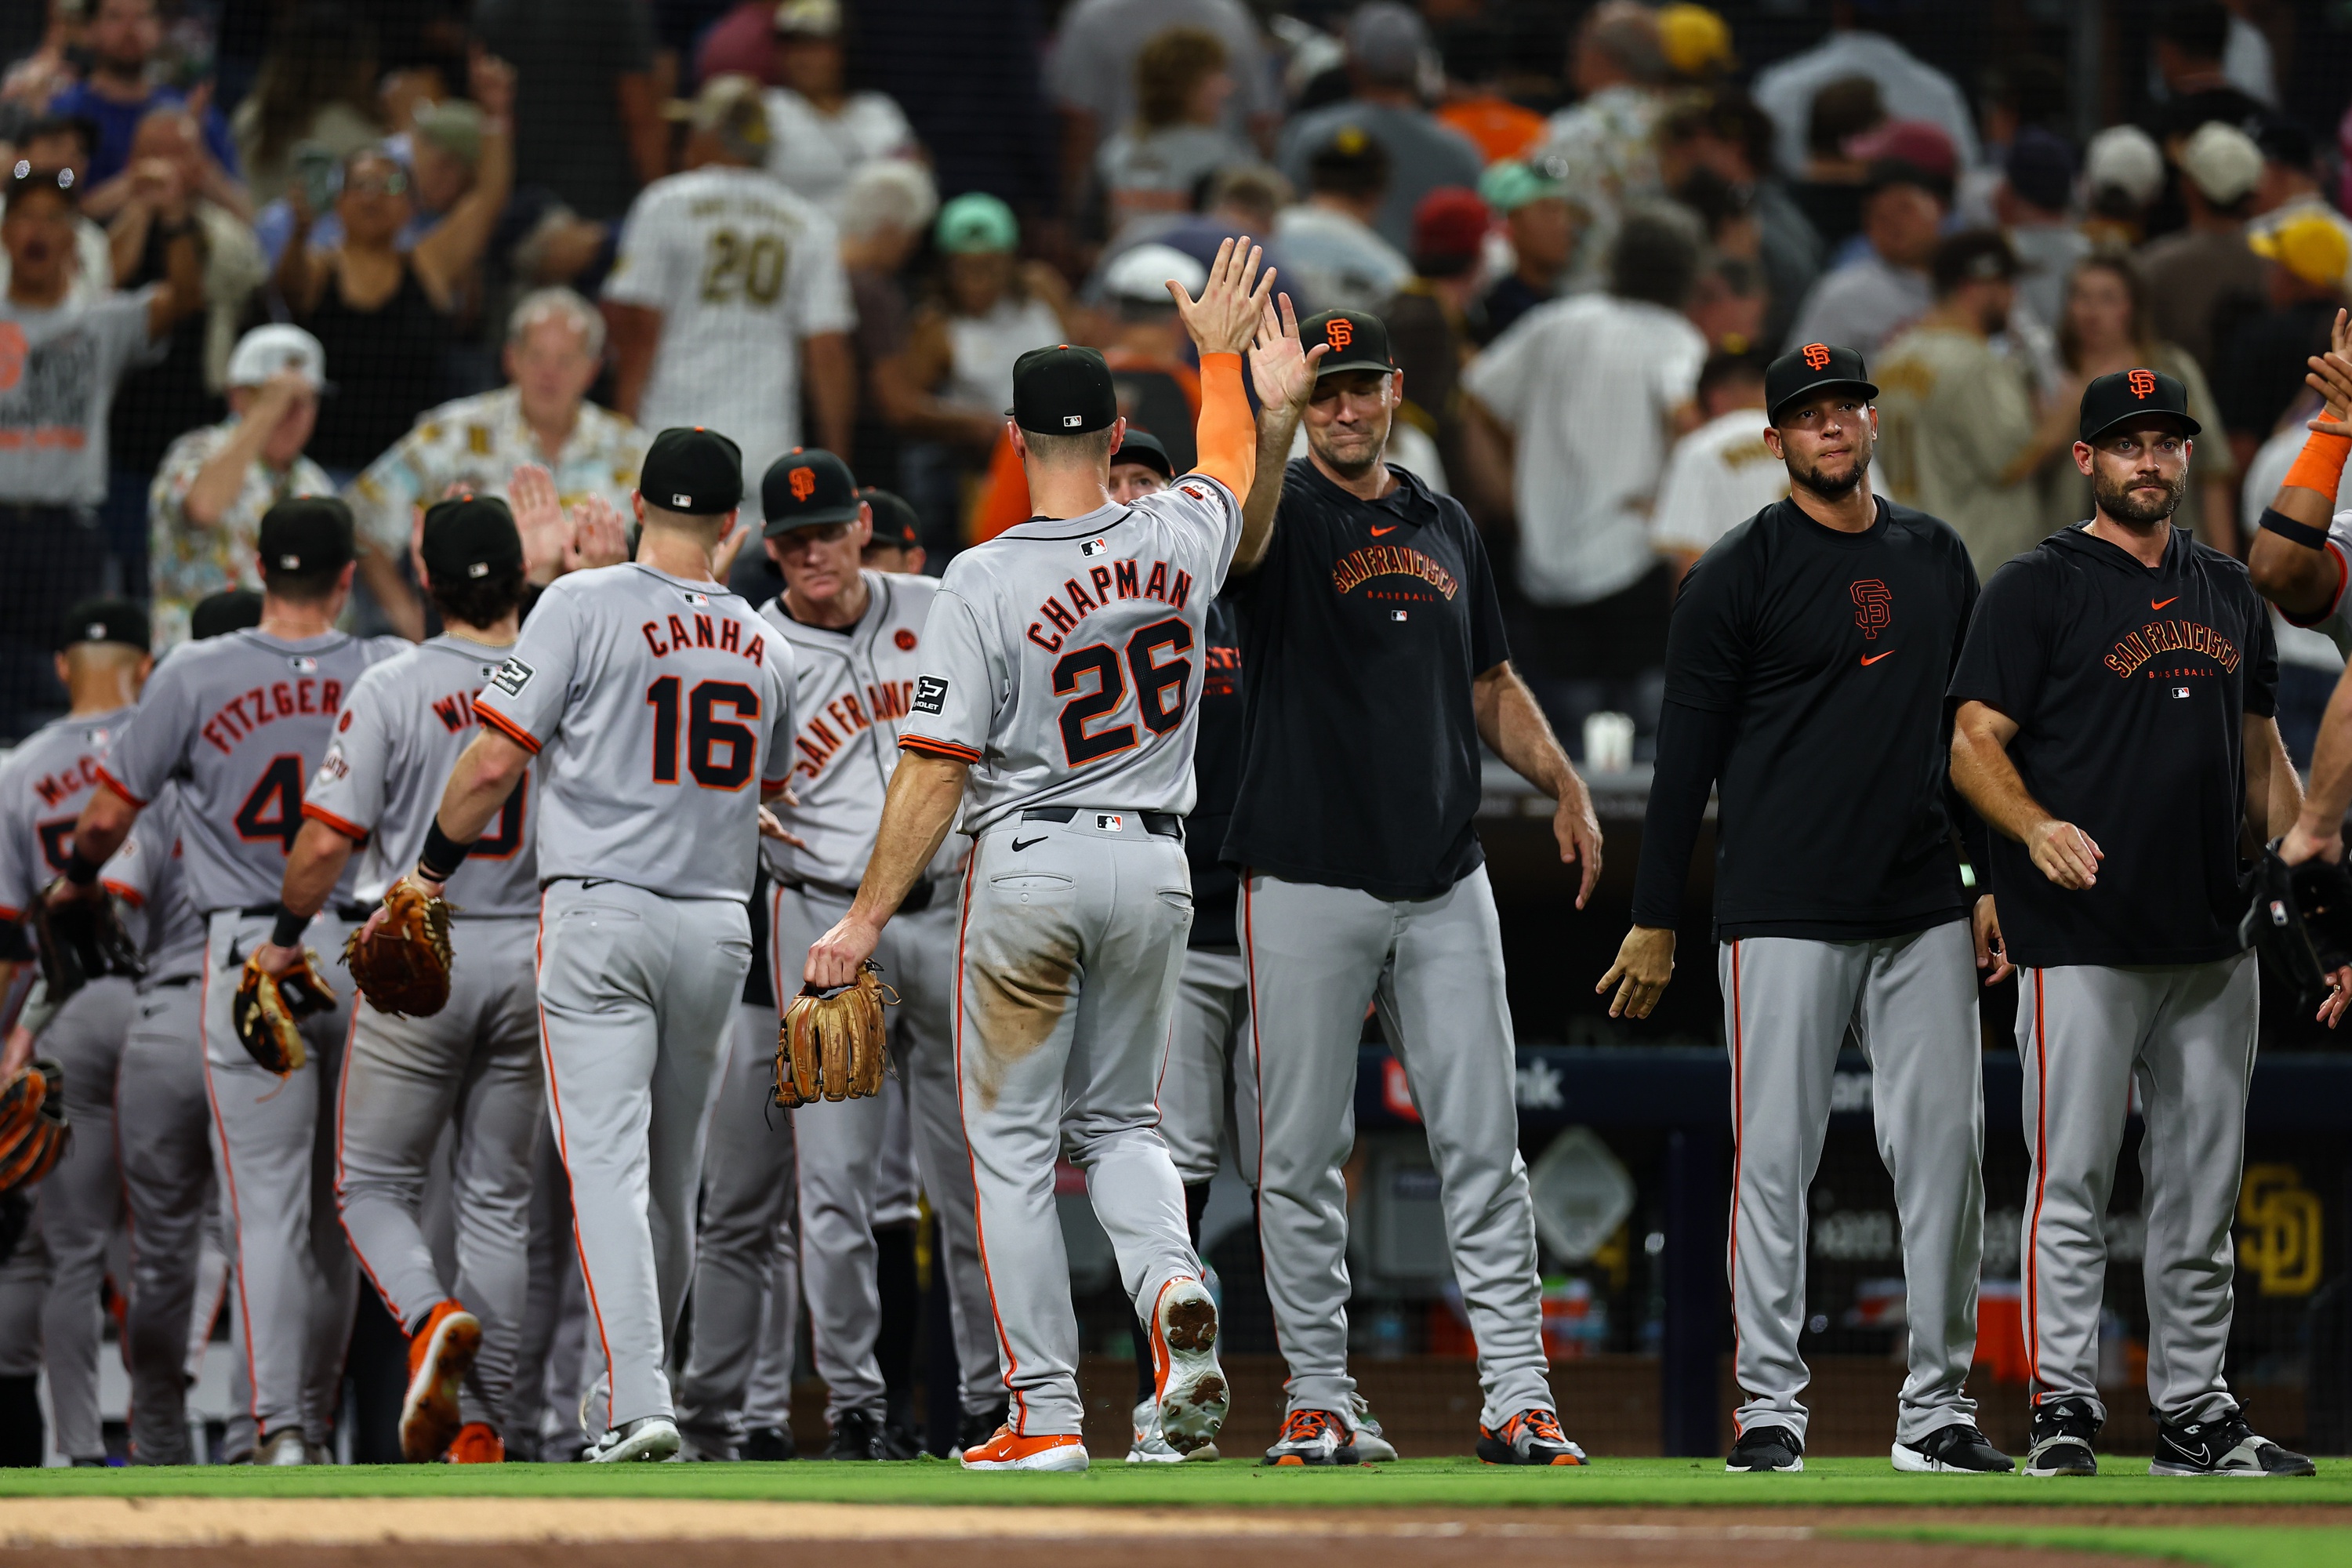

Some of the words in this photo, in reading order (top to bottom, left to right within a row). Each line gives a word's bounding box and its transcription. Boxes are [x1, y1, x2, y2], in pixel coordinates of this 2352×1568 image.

[701, 228, 789, 304] 20
[1326, 318, 1354, 352] SF
[1802, 343, 1831, 371] SF
[2127, 369, 2156, 399] SF
[1333, 550, 1373, 593] SAN
[1363, 545, 1458, 601] FRANCISCO
[1367, 590, 1434, 602] BASEBALL
[1026, 558, 1192, 655] CHAPMAN
[1849, 579, 1893, 640] SF
[642, 612, 765, 668] CANHA
[2103, 631, 2152, 679] SAN
[2142, 619, 2241, 674] FRANCISCO
[1051, 616, 1195, 768] 26
[2148, 668, 2213, 679] BASEBALL
[201, 677, 343, 755] FITZGER
[647, 674, 762, 793] 16
[795, 717, 844, 779] SAN
[233, 751, 308, 857] 4
